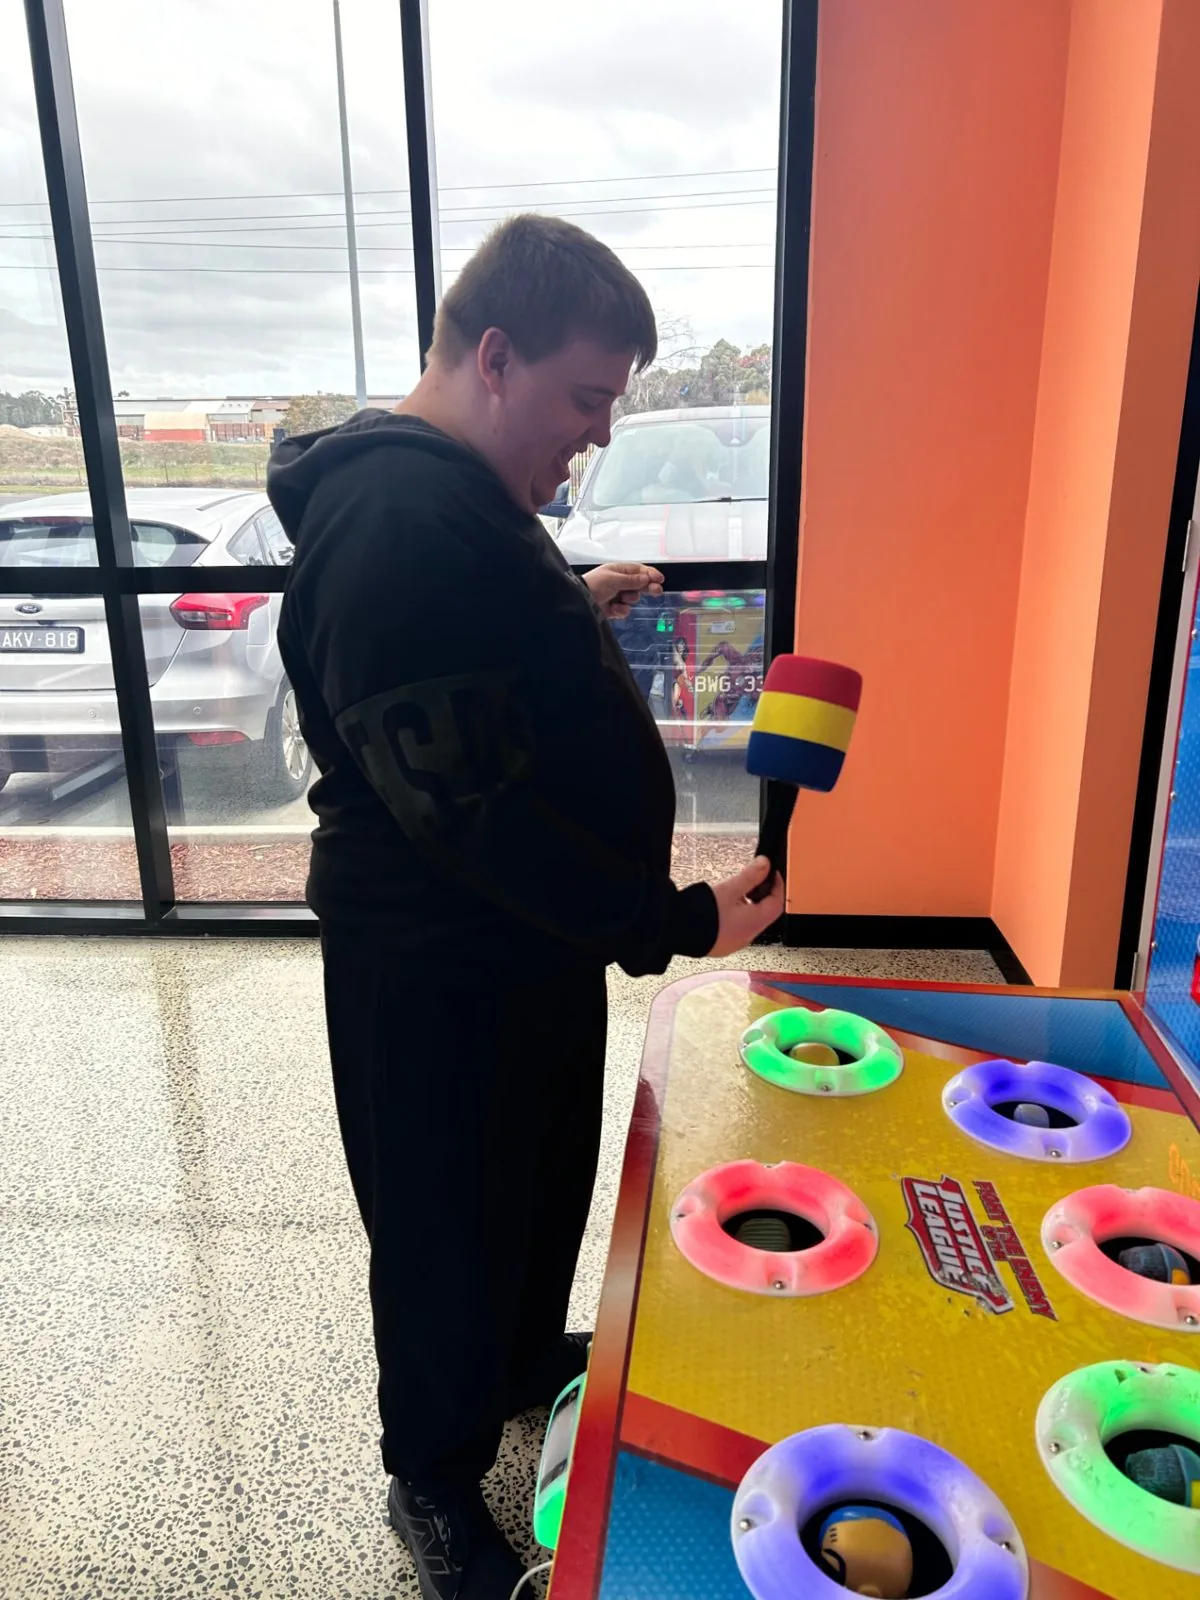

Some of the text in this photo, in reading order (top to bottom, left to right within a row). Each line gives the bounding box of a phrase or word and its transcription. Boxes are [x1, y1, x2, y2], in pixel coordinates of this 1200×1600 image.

[912, 1182, 967, 1286] LEAGUE
[935, 1185, 993, 1293] JUSTICE
[1009, 1257, 1058, 1321] ENEMY
